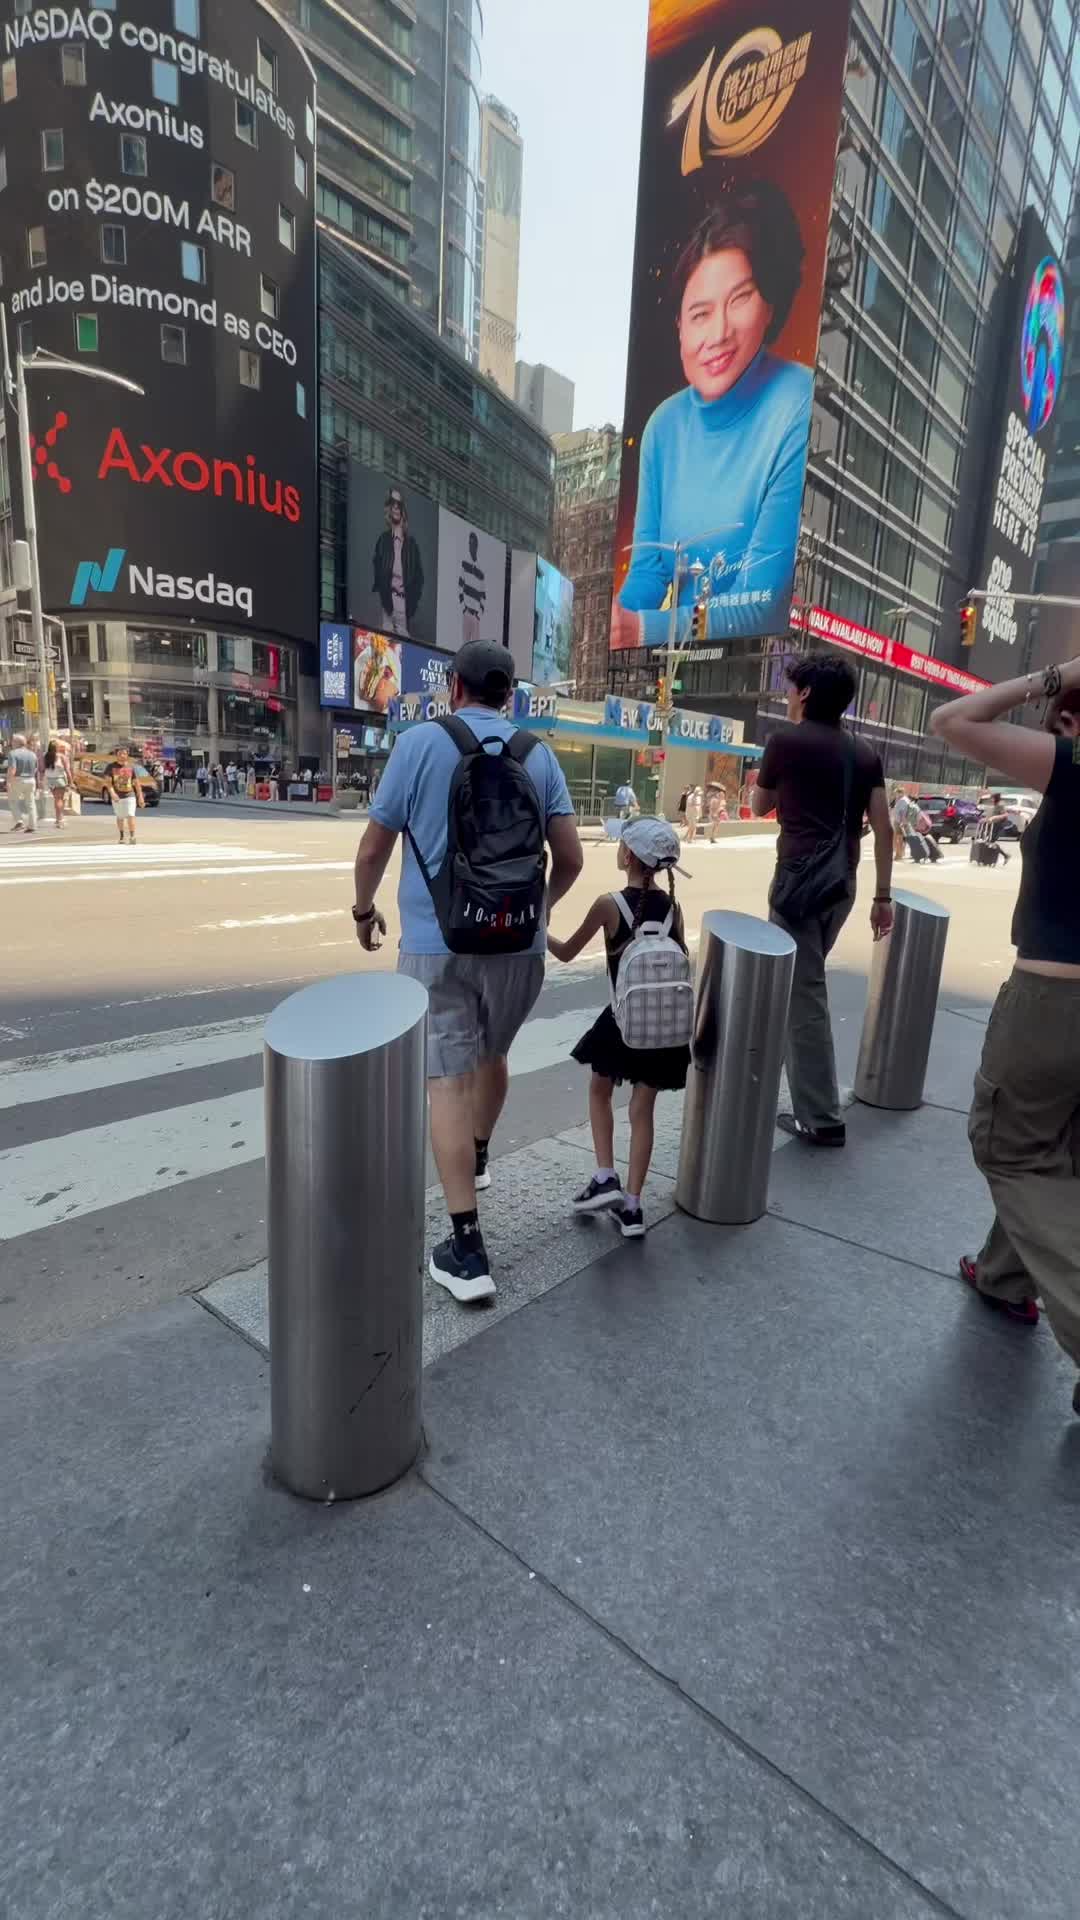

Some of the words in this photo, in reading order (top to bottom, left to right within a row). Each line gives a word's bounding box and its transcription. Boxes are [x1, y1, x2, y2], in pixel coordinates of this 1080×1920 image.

[5, 7, 113, 54] NASDAQ
[119, 20, 296, 141] congratulates
[89, 92, 205, 150] Axonius
[48, 187, 80, 212] on
[85, 178, 191, 231] $200M
[197, 208, 252, 258] ARR
[11, 277, 43, 314] and
[45, 274, 85, 304] Joe
[91, 273, 218, 328] Diamond
[224, 312, 251, 340] as
[255, 322, 297, 367] CEO
[97, 426, 301, 524] Axonius
[1006, 410, 1046, 485] SPECIAL
[1000, 444, 1043, 514] PREVIEW
[993, 499, 1022, 545] HERE
[1021, 528, 1037, 558] AT
[128, 564, 254, 618] Nasdaq
[991, 555, 1013, 591] one
[829, 618, 866, 648] AVAILABLE
[867, 634, 885, 653] NOW
[982, 603, 1018, 645] square
[463, 901, 536, 928] JORDAN
